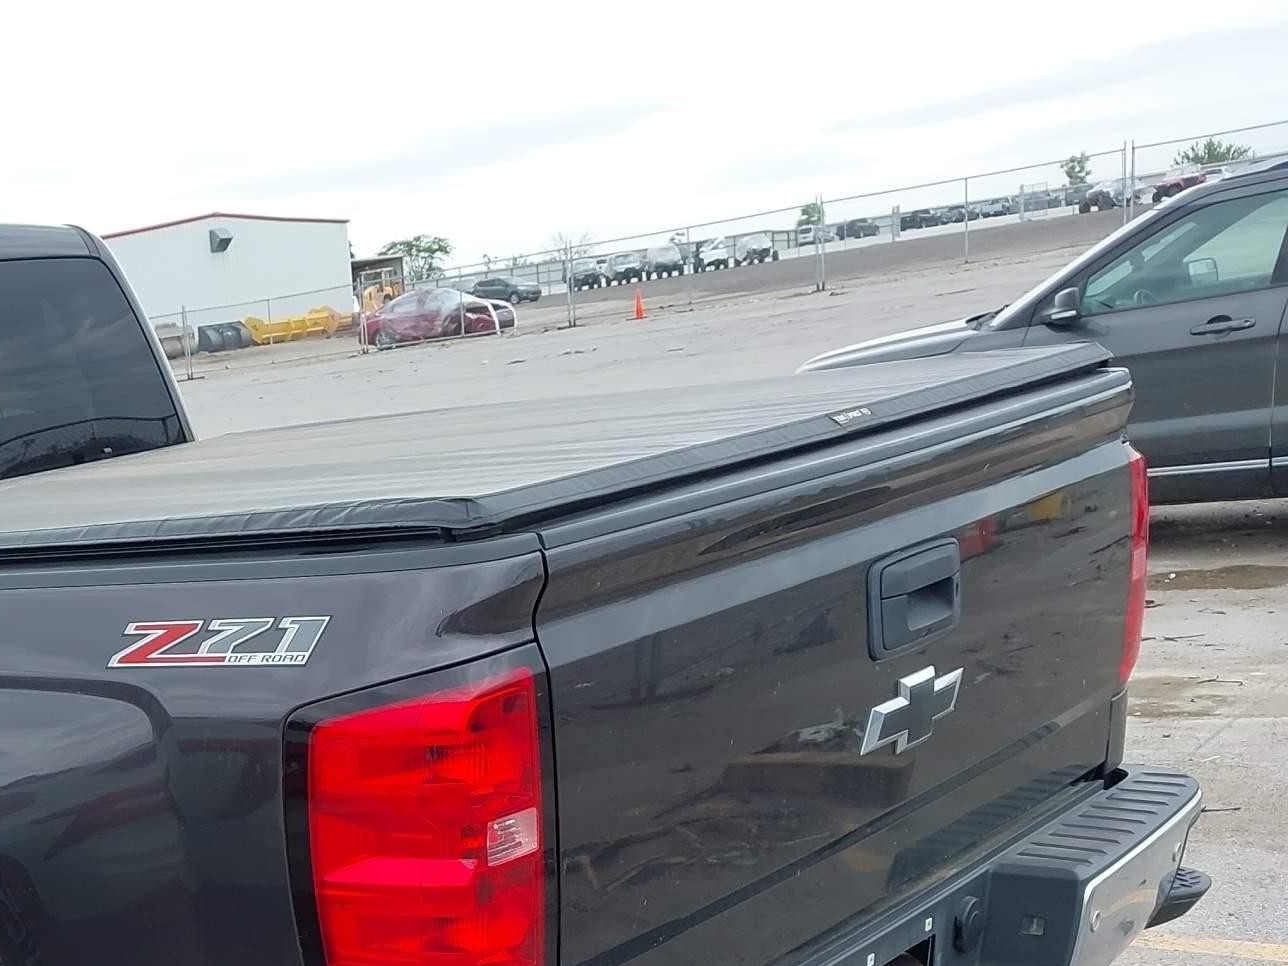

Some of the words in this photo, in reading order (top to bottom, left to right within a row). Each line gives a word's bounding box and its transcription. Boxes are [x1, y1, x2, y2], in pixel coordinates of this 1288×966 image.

[108, 615, 332, 668] Z71
[227, 653, 257, 664] OFF
[261, 653, 306, 664] ROAD
